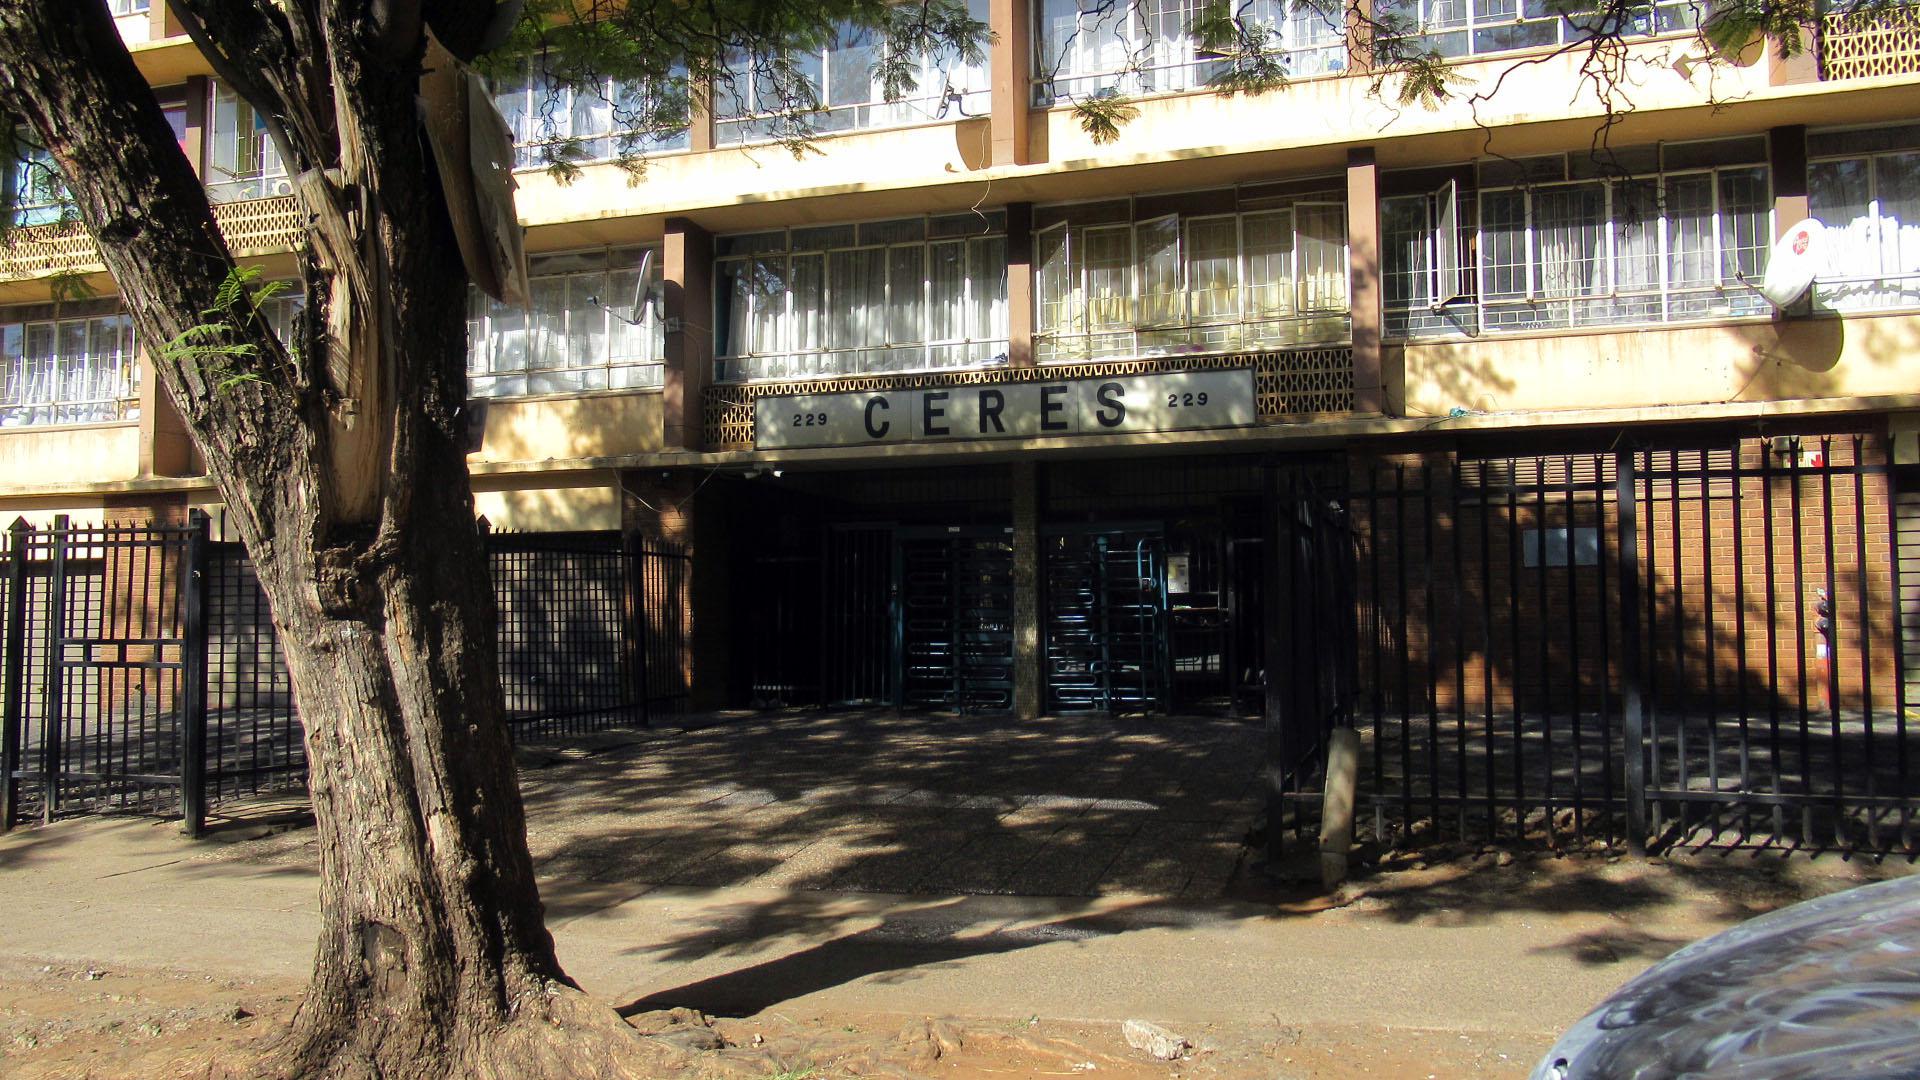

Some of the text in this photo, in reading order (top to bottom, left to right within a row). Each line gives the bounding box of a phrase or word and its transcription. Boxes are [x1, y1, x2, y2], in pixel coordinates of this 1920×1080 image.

[792, 382, 1209, 439] 229 CERES 229
